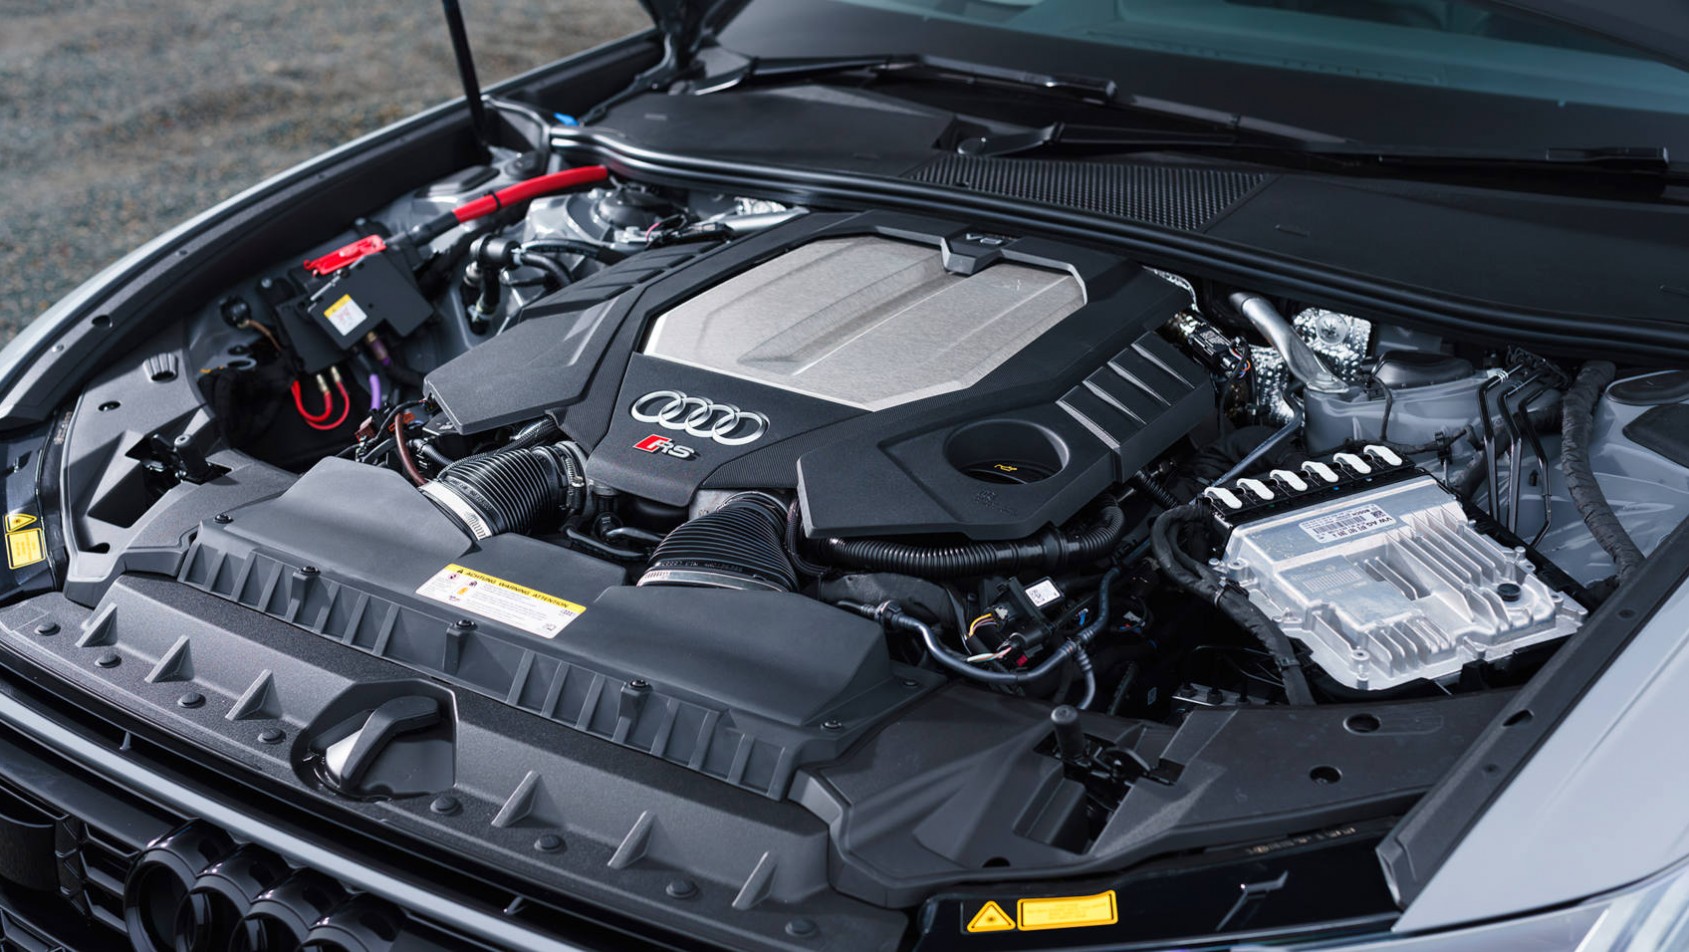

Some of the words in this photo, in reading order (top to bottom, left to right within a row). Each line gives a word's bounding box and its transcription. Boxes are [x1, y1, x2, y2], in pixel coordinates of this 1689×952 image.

[643, 438, 695, 458] RS
[465, 571, 497, 584] ACHTUNG
[498, 582, 530, 596] WARNING
[532, 592, 569, 608] ATTENTION
